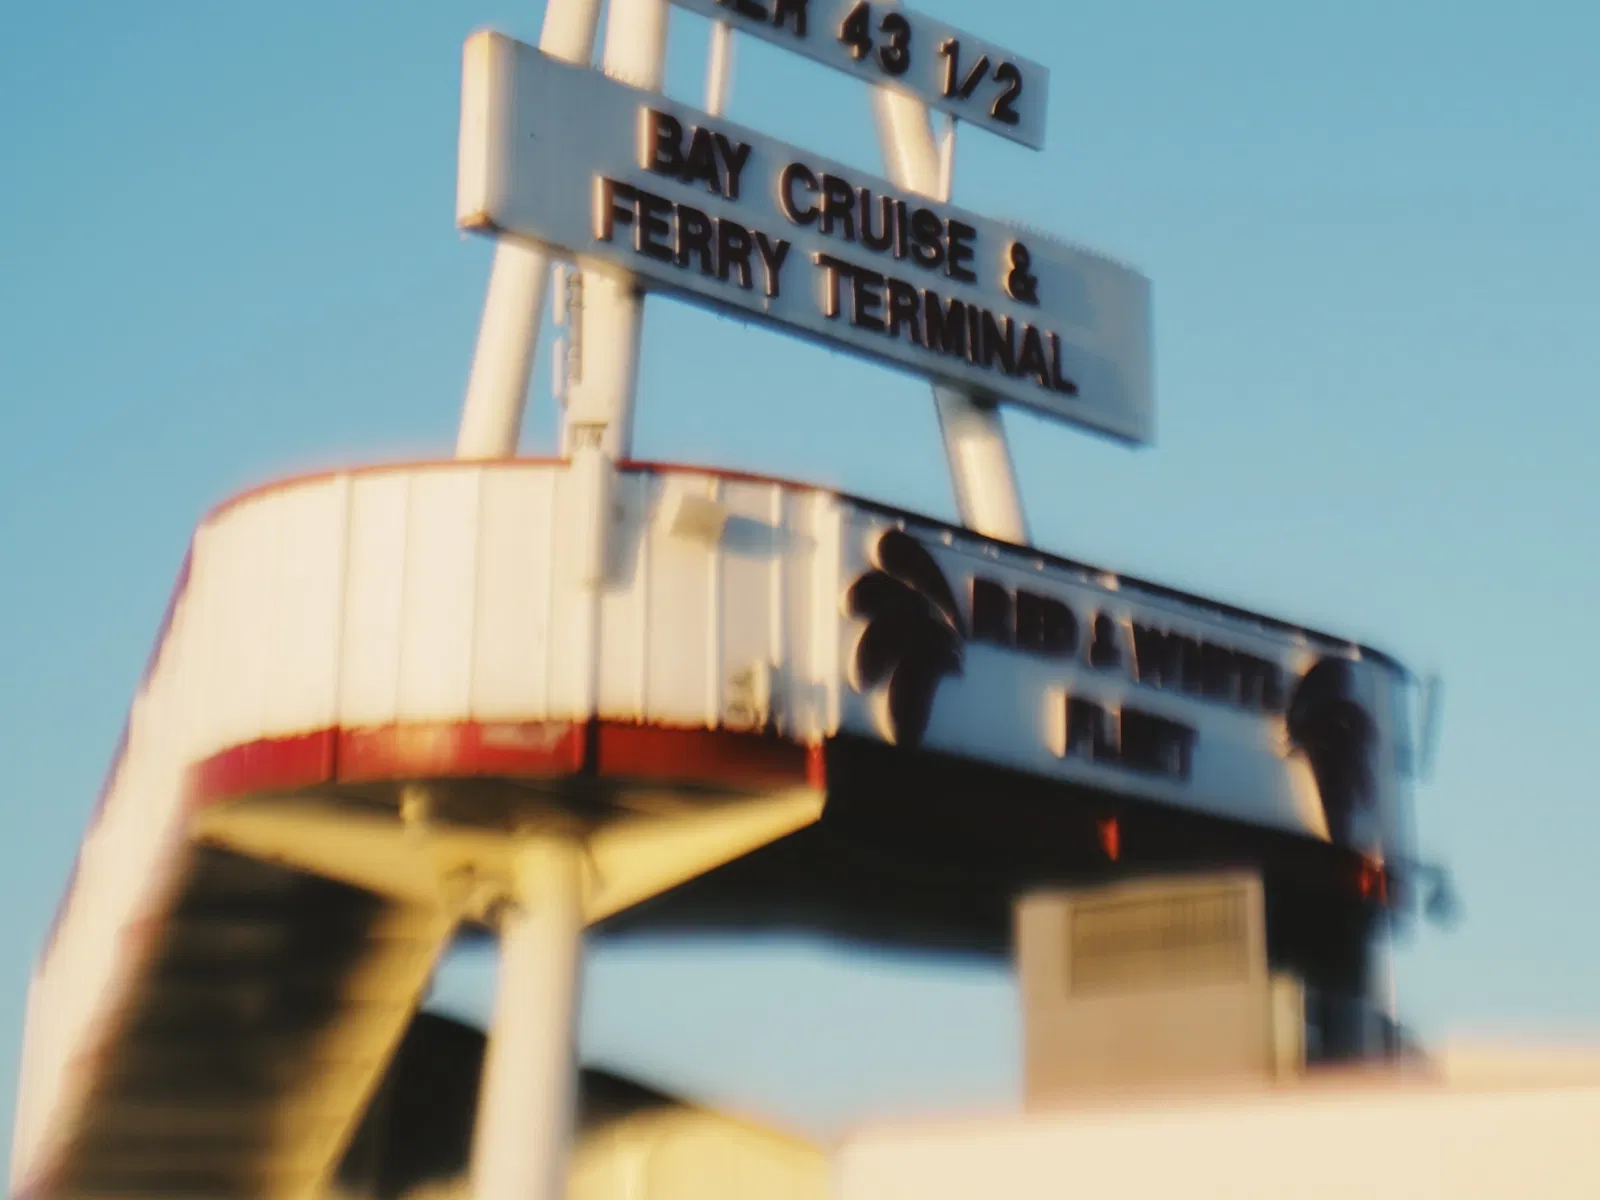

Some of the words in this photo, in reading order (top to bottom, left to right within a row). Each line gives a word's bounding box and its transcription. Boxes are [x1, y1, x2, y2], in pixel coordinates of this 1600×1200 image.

[837, 0, 912, 77] 43
[938, 36, 1023, 126] 1/2
[592, 174, 790, 298] FERRY
[812, 251, 1079, 394] TERMINAL
[638, 106, 752, 199] BAY
[778, 162, 978, 284] CRUISE
[1004, 240, 1040, 306] &
